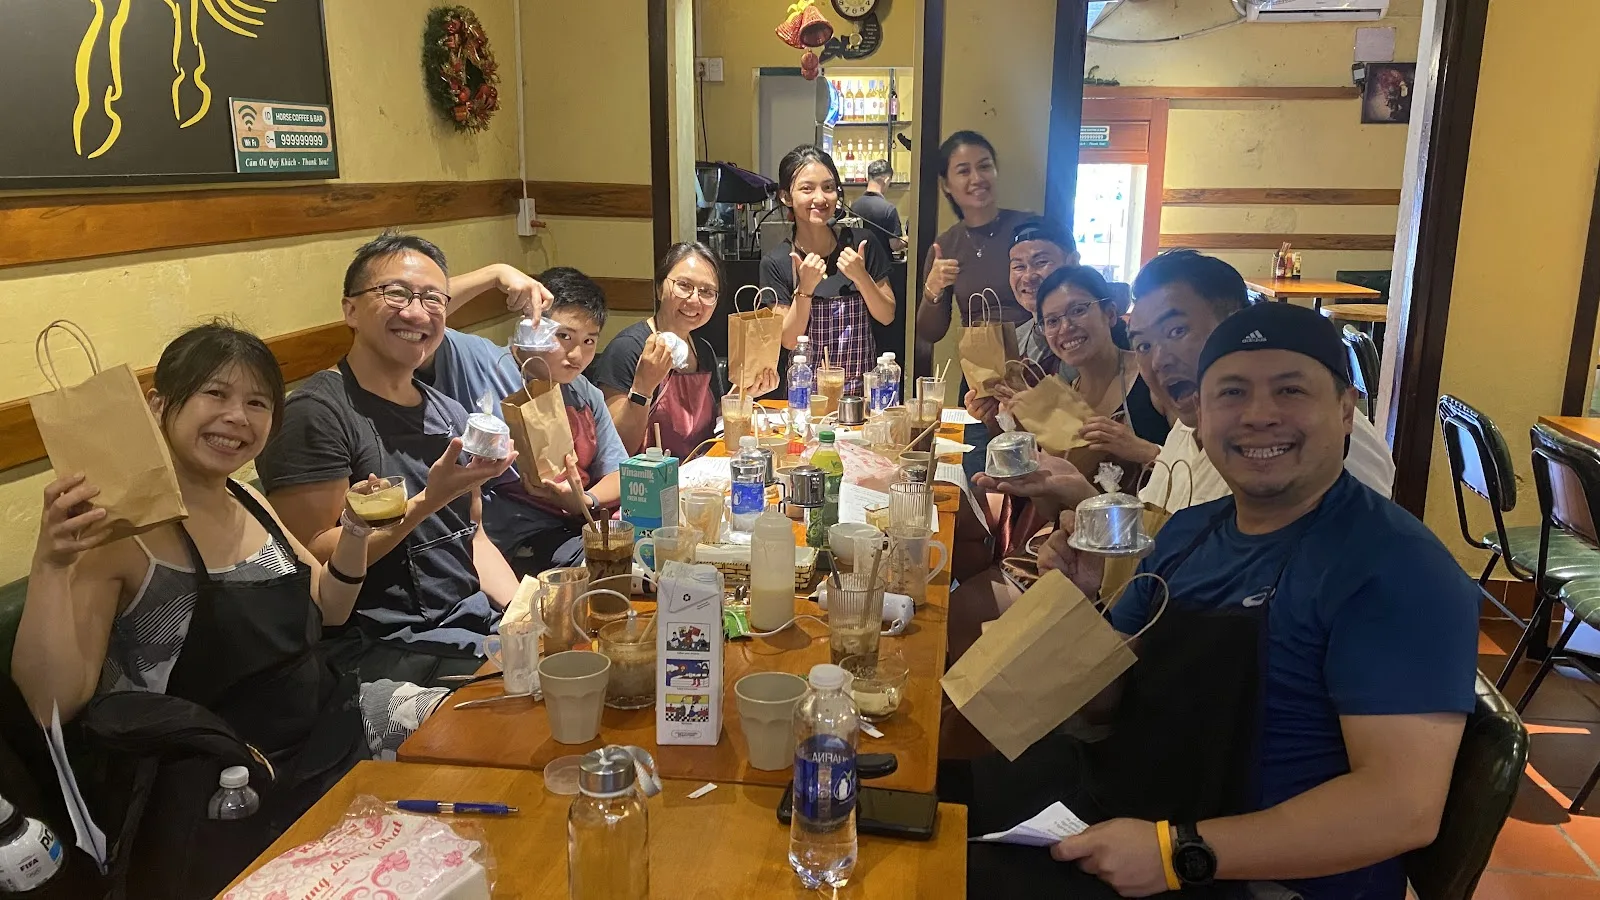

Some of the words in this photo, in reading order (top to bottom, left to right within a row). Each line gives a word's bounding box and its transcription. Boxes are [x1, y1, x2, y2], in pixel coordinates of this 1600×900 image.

[275, 112, 292, 121] HORSE
[292, 113, 309, 122] COFFEE
[310, 114, 313, 122] &
[313, 114, 323, 123] BAR
[281, 134, 322, 146] 999999999
[281, 157, 297, 166] Khách
[302, 157, 317, 166] Thank
[621, 466, 655, 480] Vinamilk
[20, 858, 39, 872] FIFA
